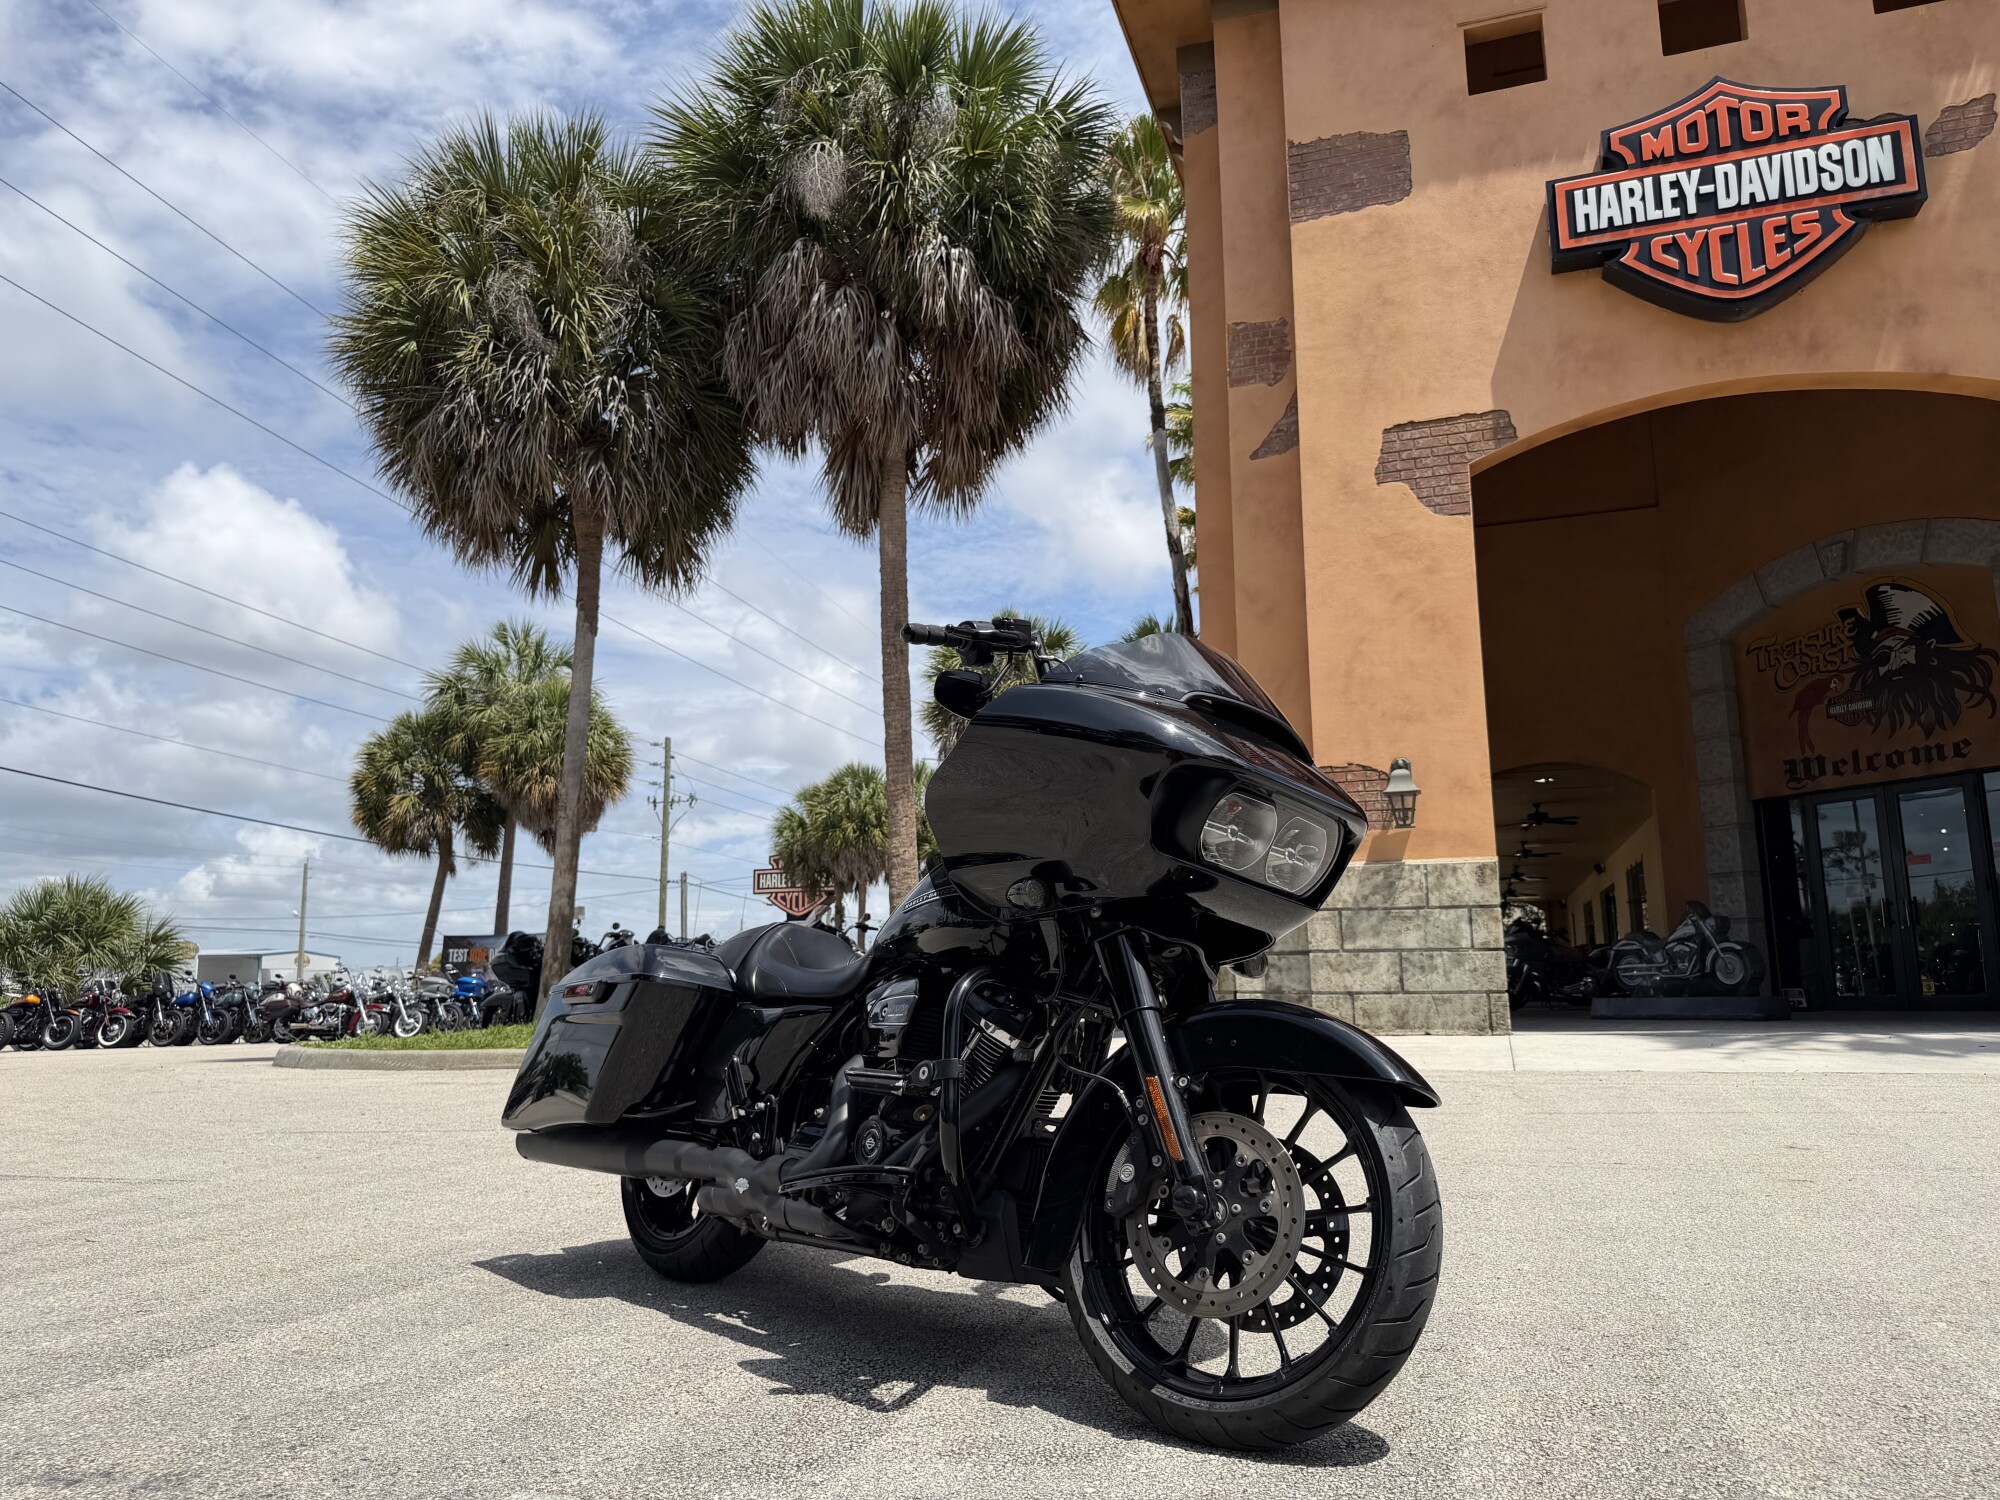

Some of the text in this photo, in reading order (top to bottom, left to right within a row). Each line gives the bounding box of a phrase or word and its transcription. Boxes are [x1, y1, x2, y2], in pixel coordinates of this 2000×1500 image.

[1640, 95, 1811, 162] MOTOR
[1573, 134, 1896, 233] HARLEY-DAVIDSON
[1650, 209, 1822, 285] CYCLES
[1783, 737, 1973, 790] Welcome
[777, 891, 820, 912] CYCLE
[448, 948, 469, 963] TEST
